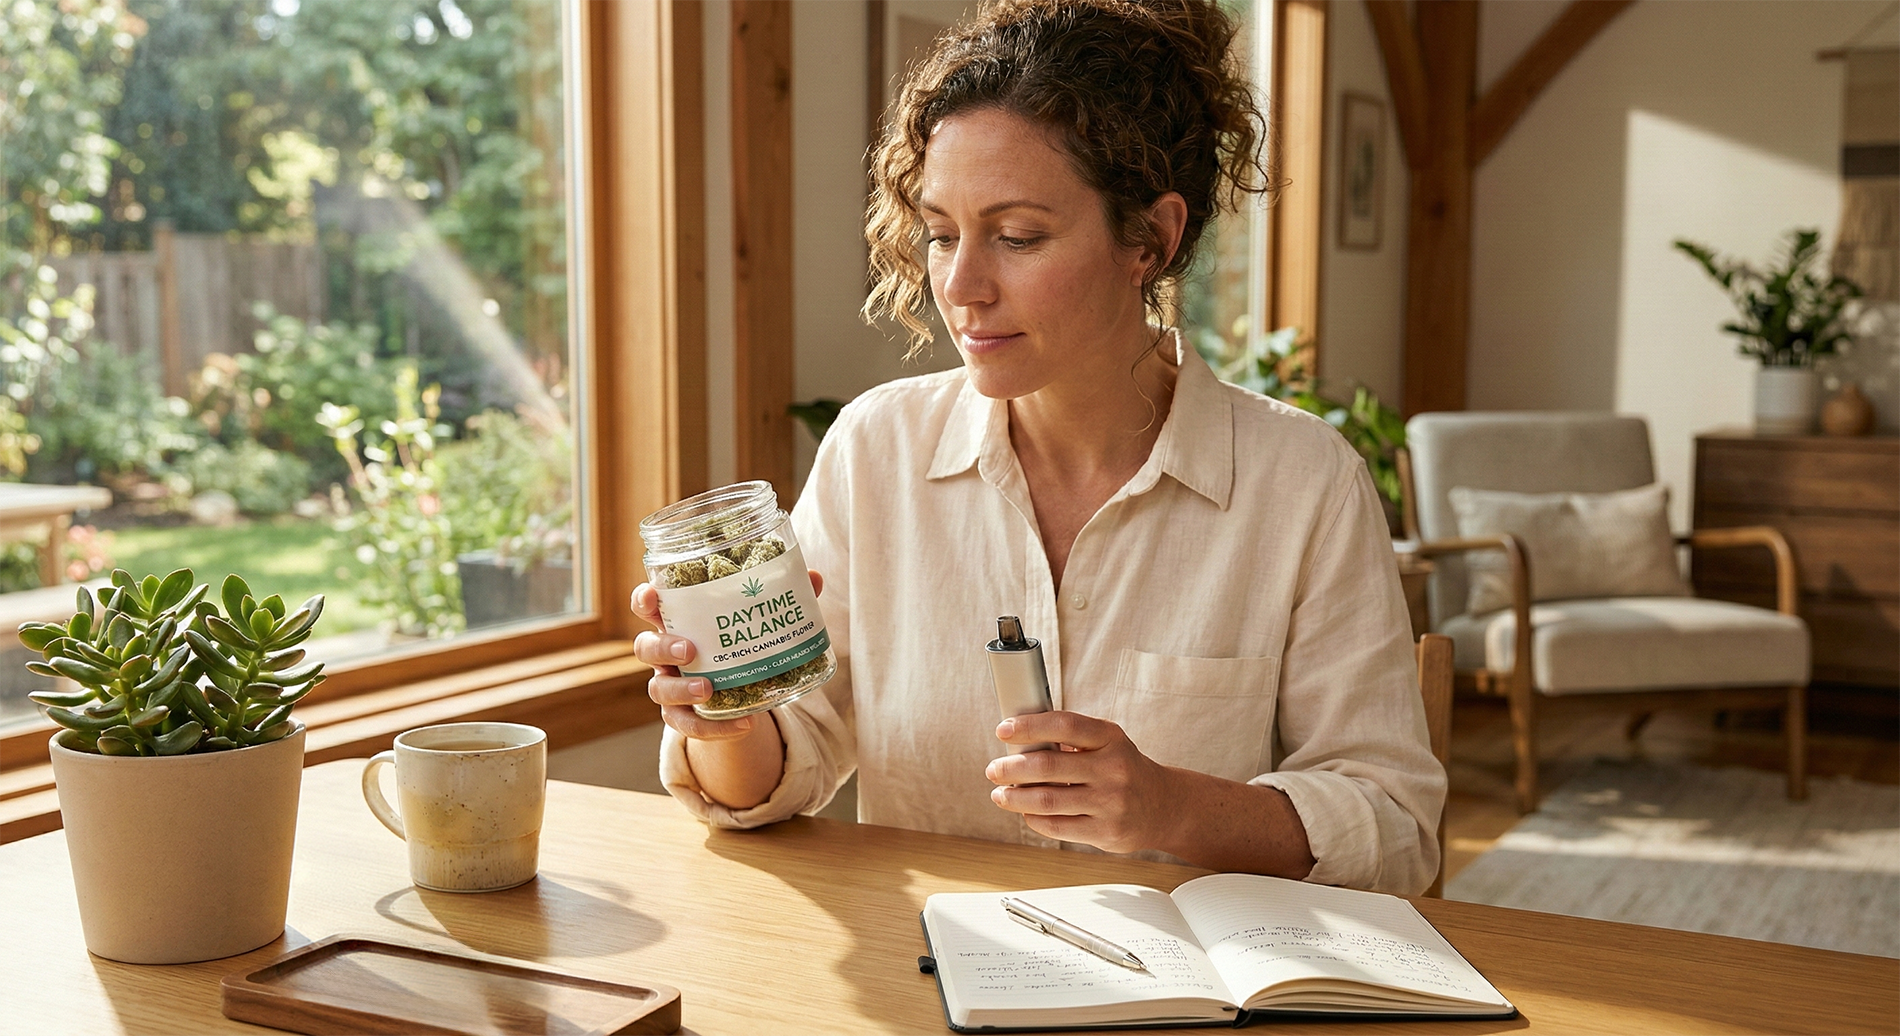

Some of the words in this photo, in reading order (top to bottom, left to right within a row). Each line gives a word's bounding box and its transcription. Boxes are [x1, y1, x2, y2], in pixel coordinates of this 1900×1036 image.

[715, 590, 797, 630] DAYTIME
[718, 605, 805, 648] BALANCE
[713, 649, 752, 663] CBC-RICH
[752, 633, 792, 653] CANNABIS
[792, 621, 815, 638] FLOWER
